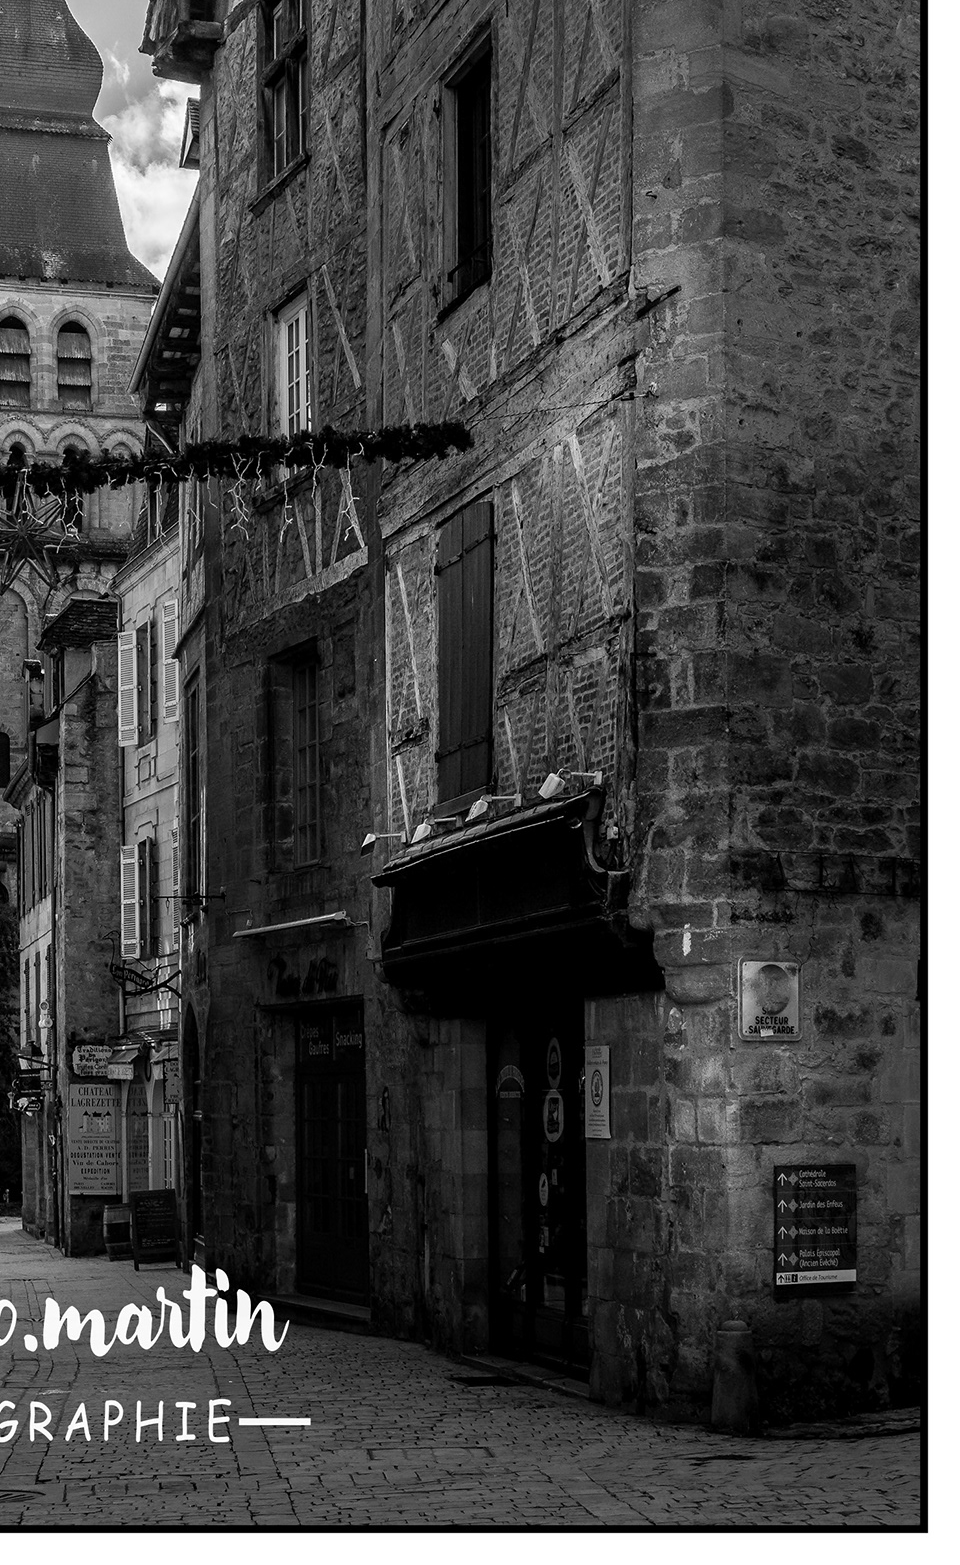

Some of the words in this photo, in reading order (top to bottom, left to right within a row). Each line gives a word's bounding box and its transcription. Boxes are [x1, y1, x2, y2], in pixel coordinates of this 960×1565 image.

[755, 1016, 789, 1025] SECTEUR
[335, 1030, 363, 1049] Snacking
[78, 1087, 114, 1096] CHATEAU
[71, 1098, 122, 1108] LAGREZETTE
[799, 1169, 827, 1178] Cathédrale
[799, 1179, 837, 1188] Saint-Sacerdos
[799, 1200, 816, 1209] Jardin
[817, 1200, 826, 1208] des
[826, 1199, 844, 1208] Enfeus
[799, 1227, 817, 1236] Maison
[817, 1227, 824, 1235] de
[824, 1226, 831, 1235] la
[799, 1249, 816, 1258] Palais
[799, 1258, 819, 1269] (Ancien
